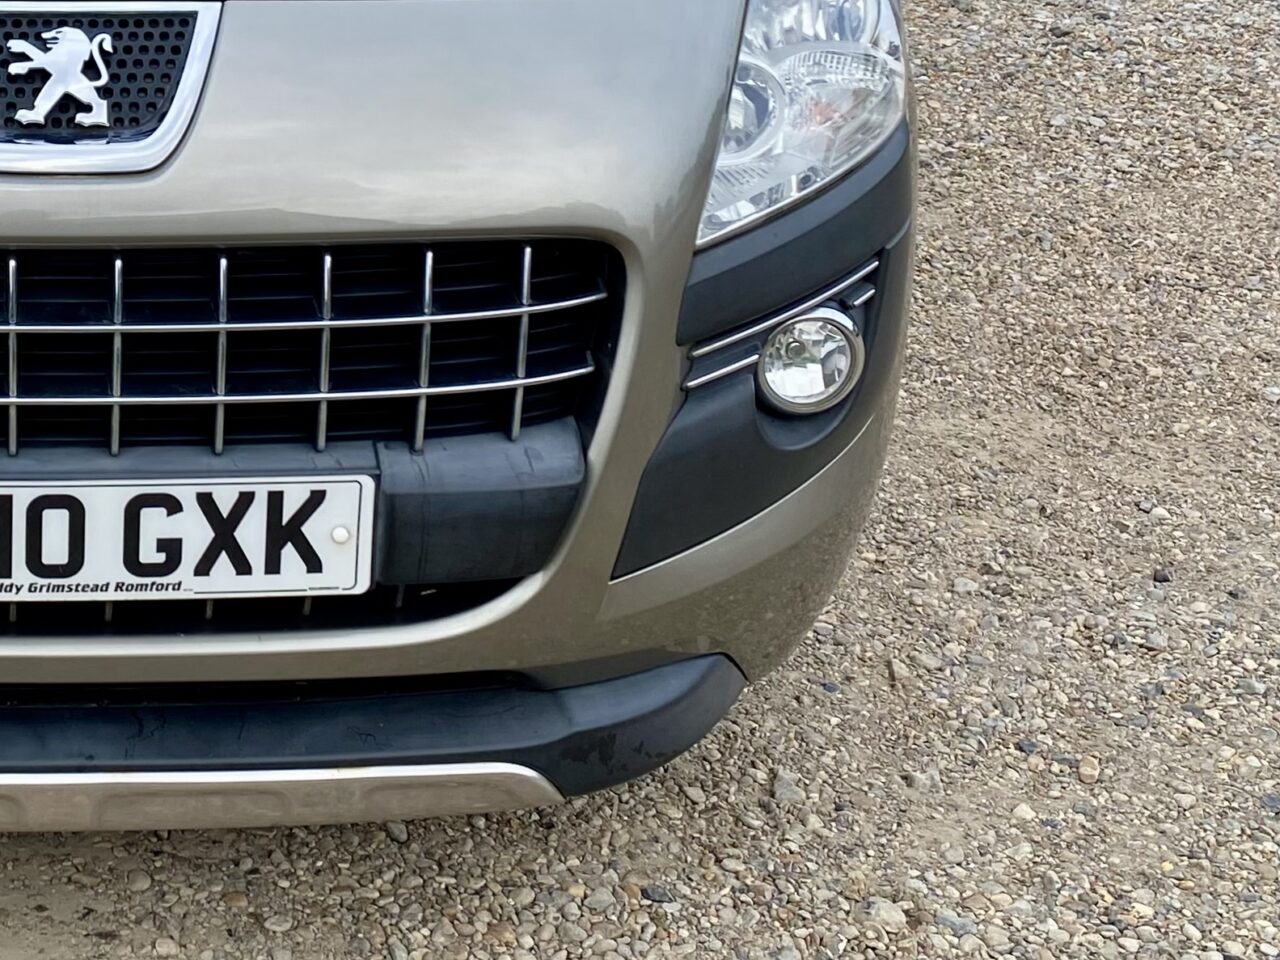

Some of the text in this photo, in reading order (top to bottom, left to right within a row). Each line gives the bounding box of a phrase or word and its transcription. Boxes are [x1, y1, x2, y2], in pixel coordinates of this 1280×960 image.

[123, 490, 328, 577] GXK
[27, 581, 111, 593] Grimstead
[114, 580, 183, 592] Romford
